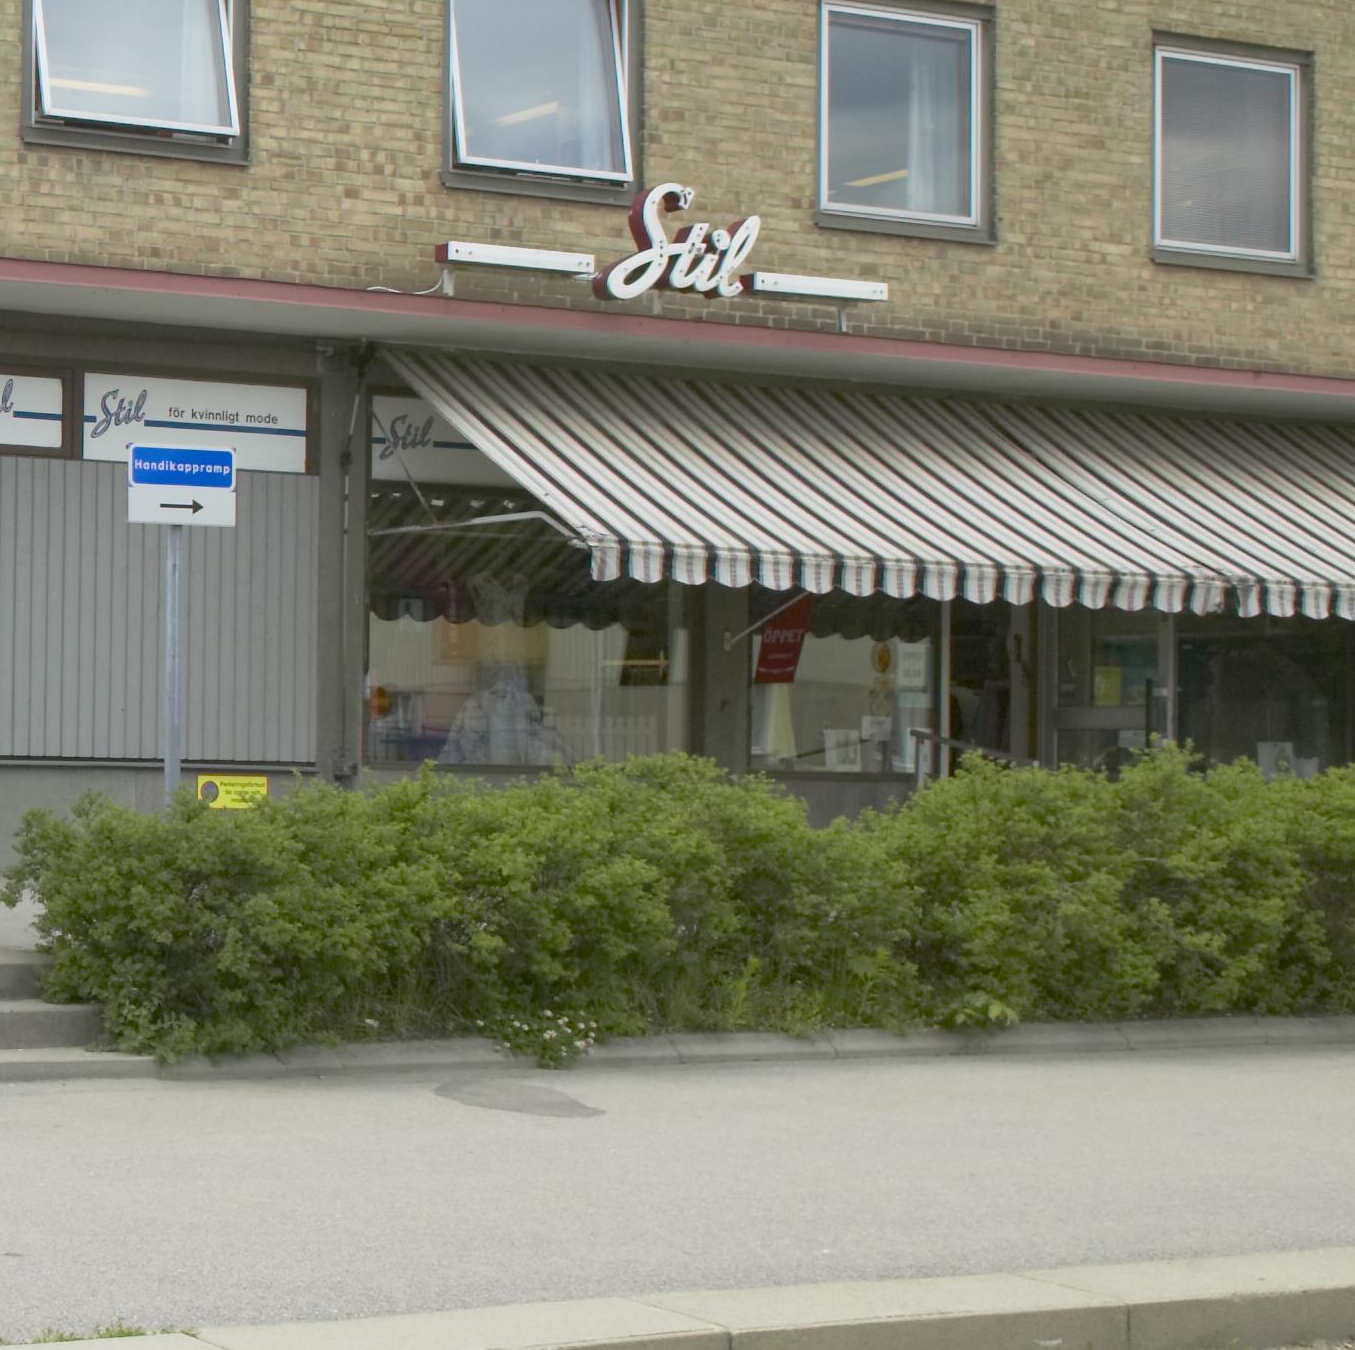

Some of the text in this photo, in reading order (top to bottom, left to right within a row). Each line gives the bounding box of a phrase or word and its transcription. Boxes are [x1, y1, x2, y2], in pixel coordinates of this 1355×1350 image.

[593, 182, 761, 301] Stil
[90, 388, 148, 439] Stil
[168, 407, 279, 425] för kvinnligt mode
[379, 414, 434, 460] Stil
[134, 459, 231, 475] Handikappramp
[763, 627, 805, 644] ÖPPET
